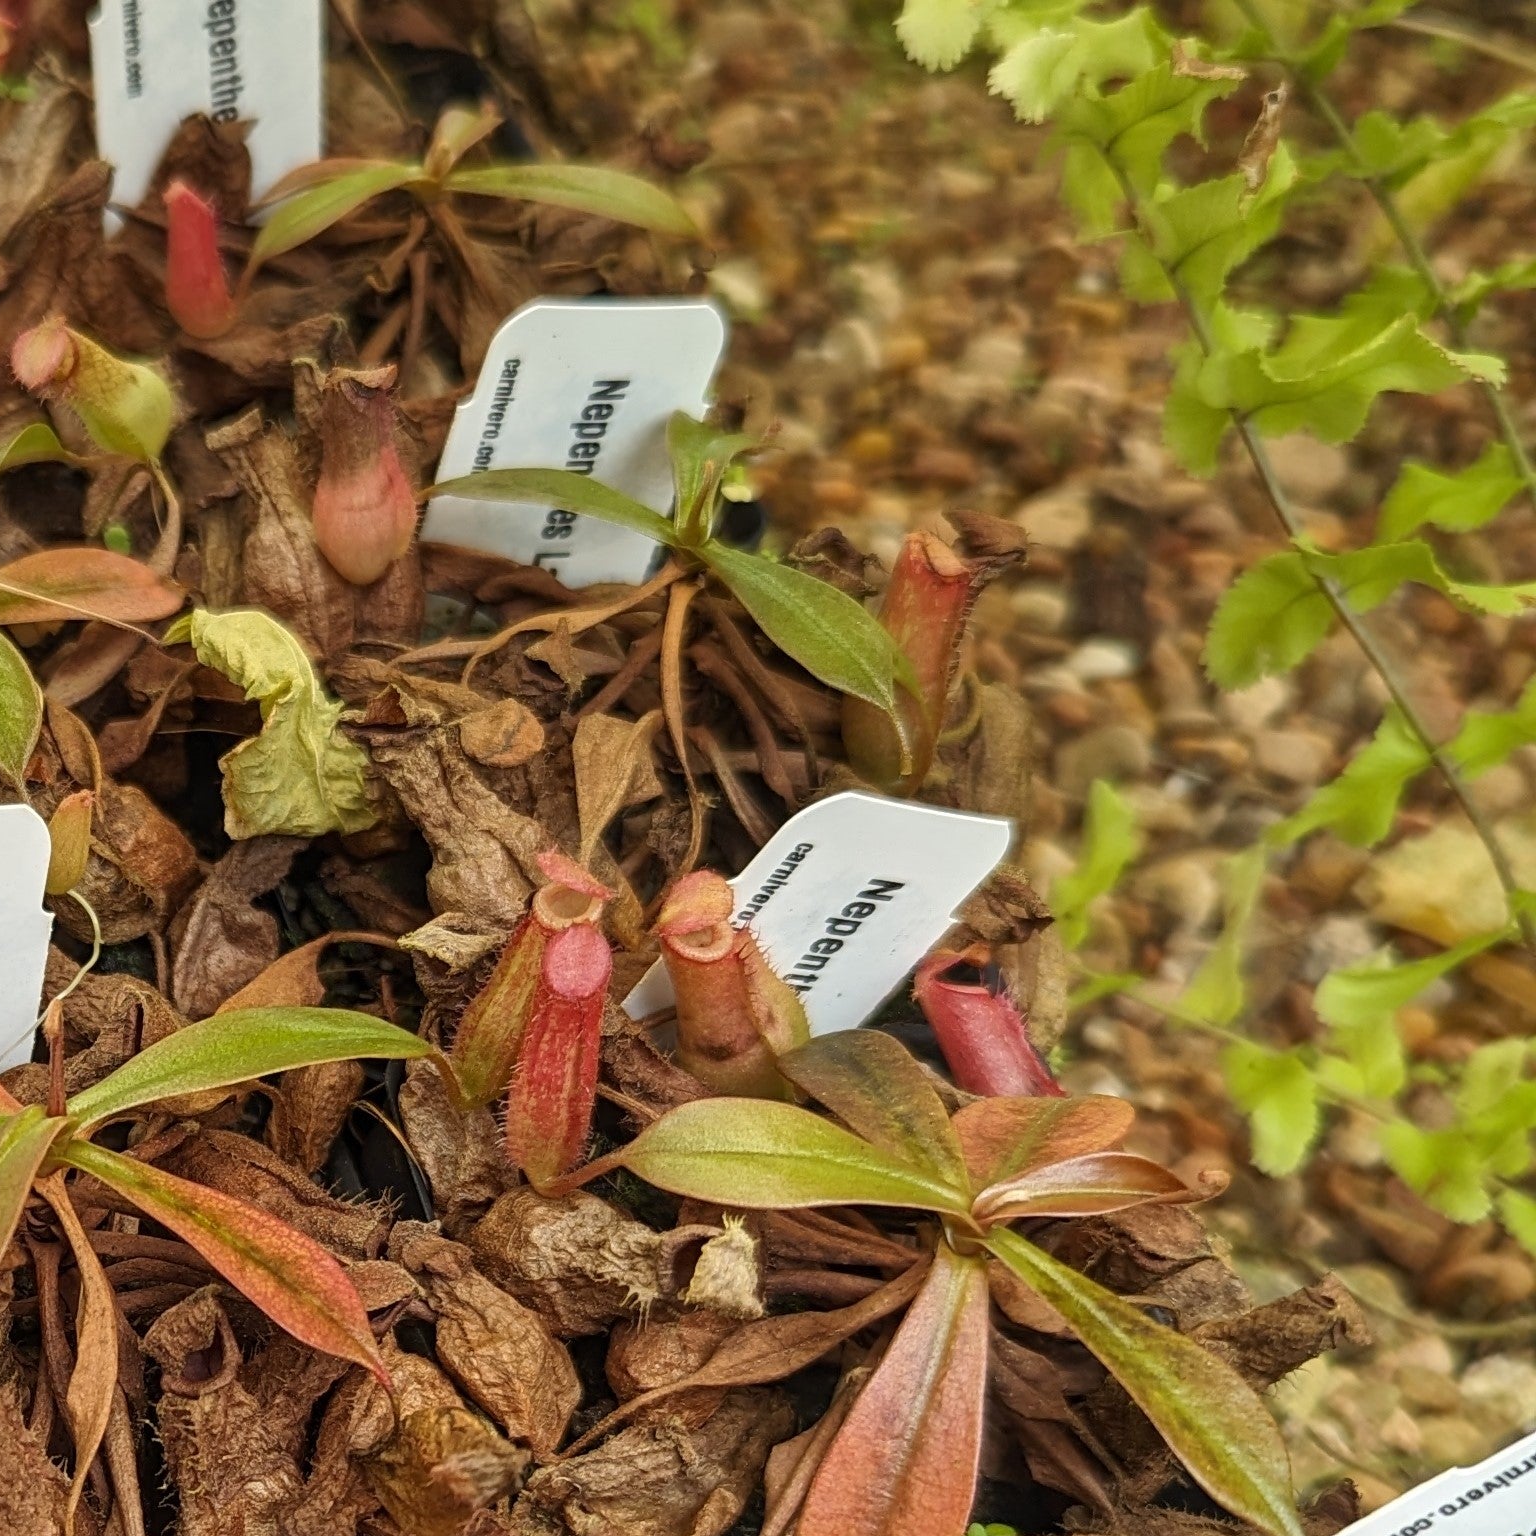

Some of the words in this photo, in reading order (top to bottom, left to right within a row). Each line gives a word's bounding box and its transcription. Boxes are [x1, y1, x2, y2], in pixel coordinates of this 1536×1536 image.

[202, 0, 244, 124] epenthe
[541, 380, 630, 539] Nepenes
[783, 878, 905, 996] Nepent
